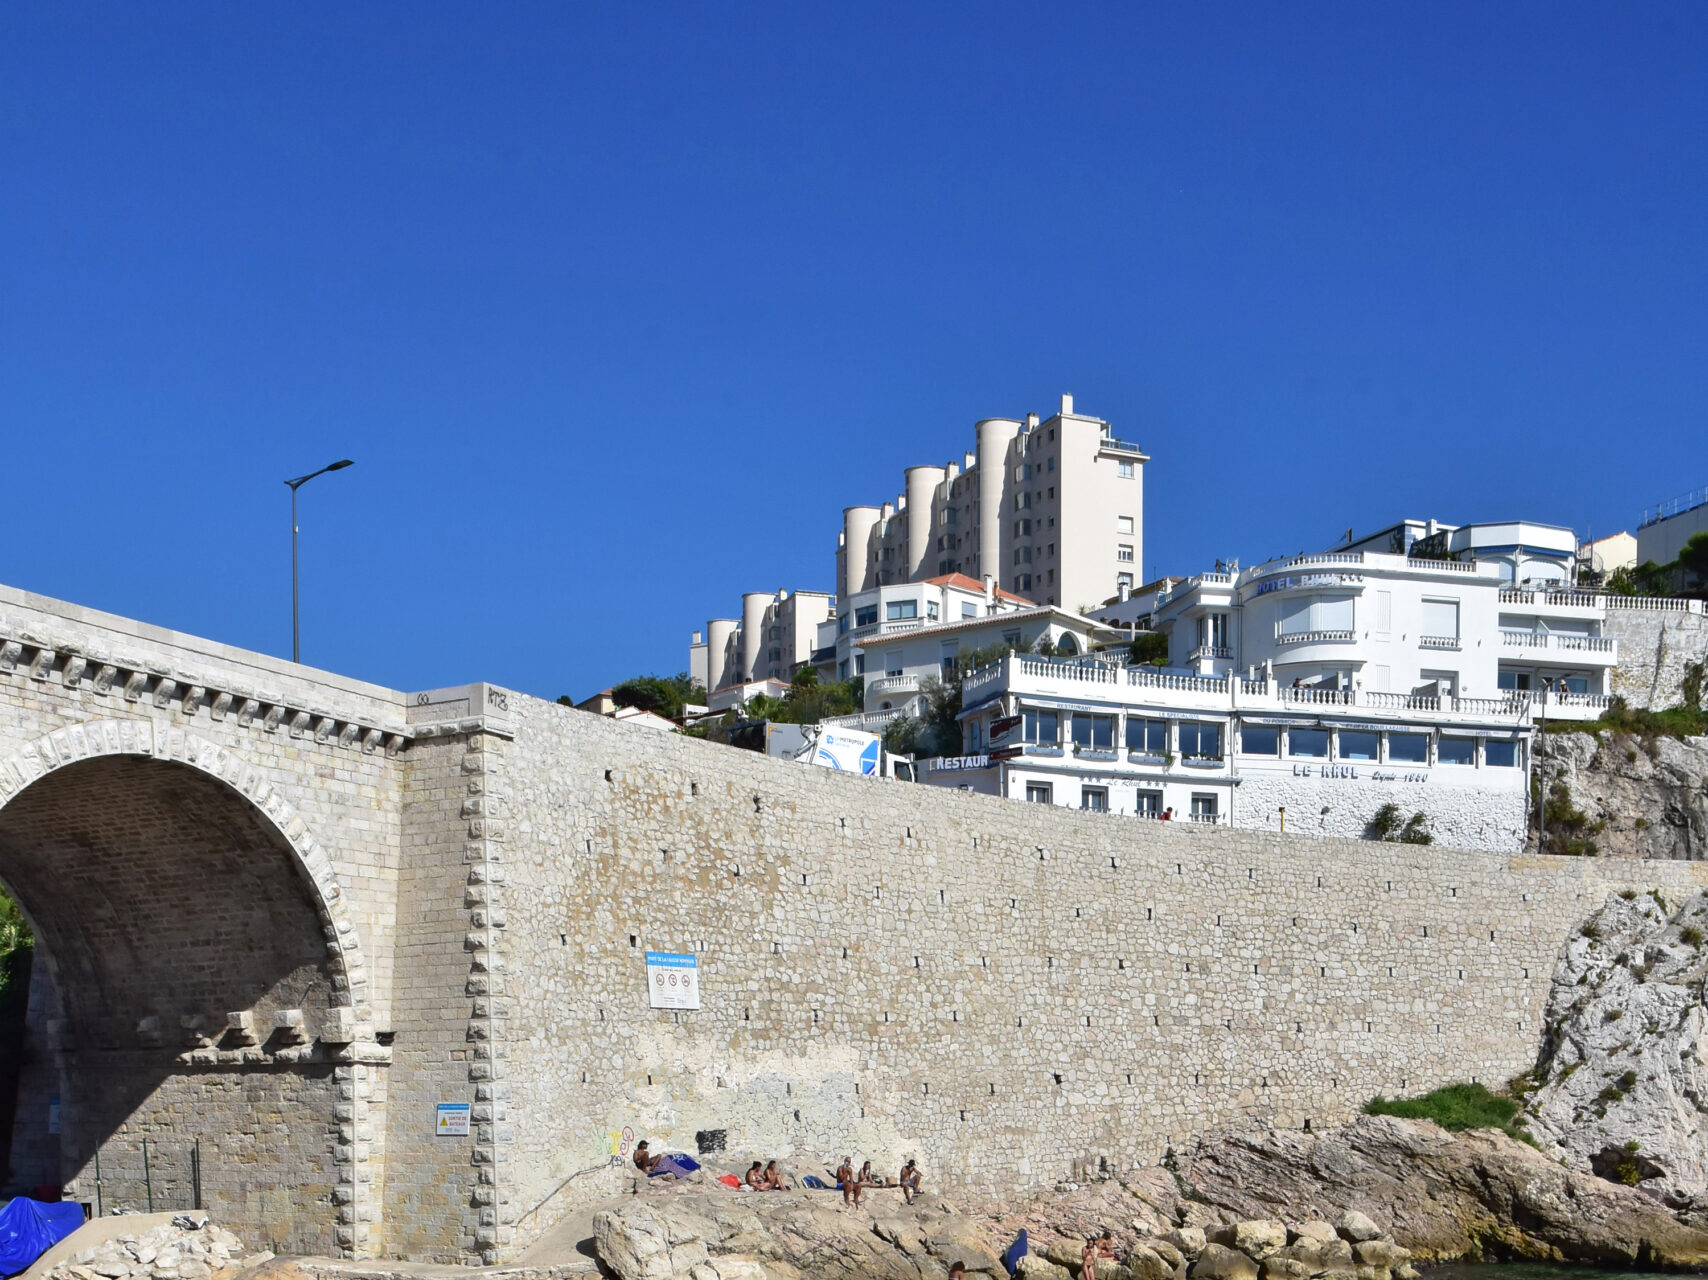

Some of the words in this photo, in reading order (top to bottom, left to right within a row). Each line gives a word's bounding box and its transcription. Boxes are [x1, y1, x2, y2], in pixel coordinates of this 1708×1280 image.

[1257, 577, 1293, 594] HOTEL
[1293, 764, 1311, 778] LE
[1321, 765, 1360, 779] RHUL
